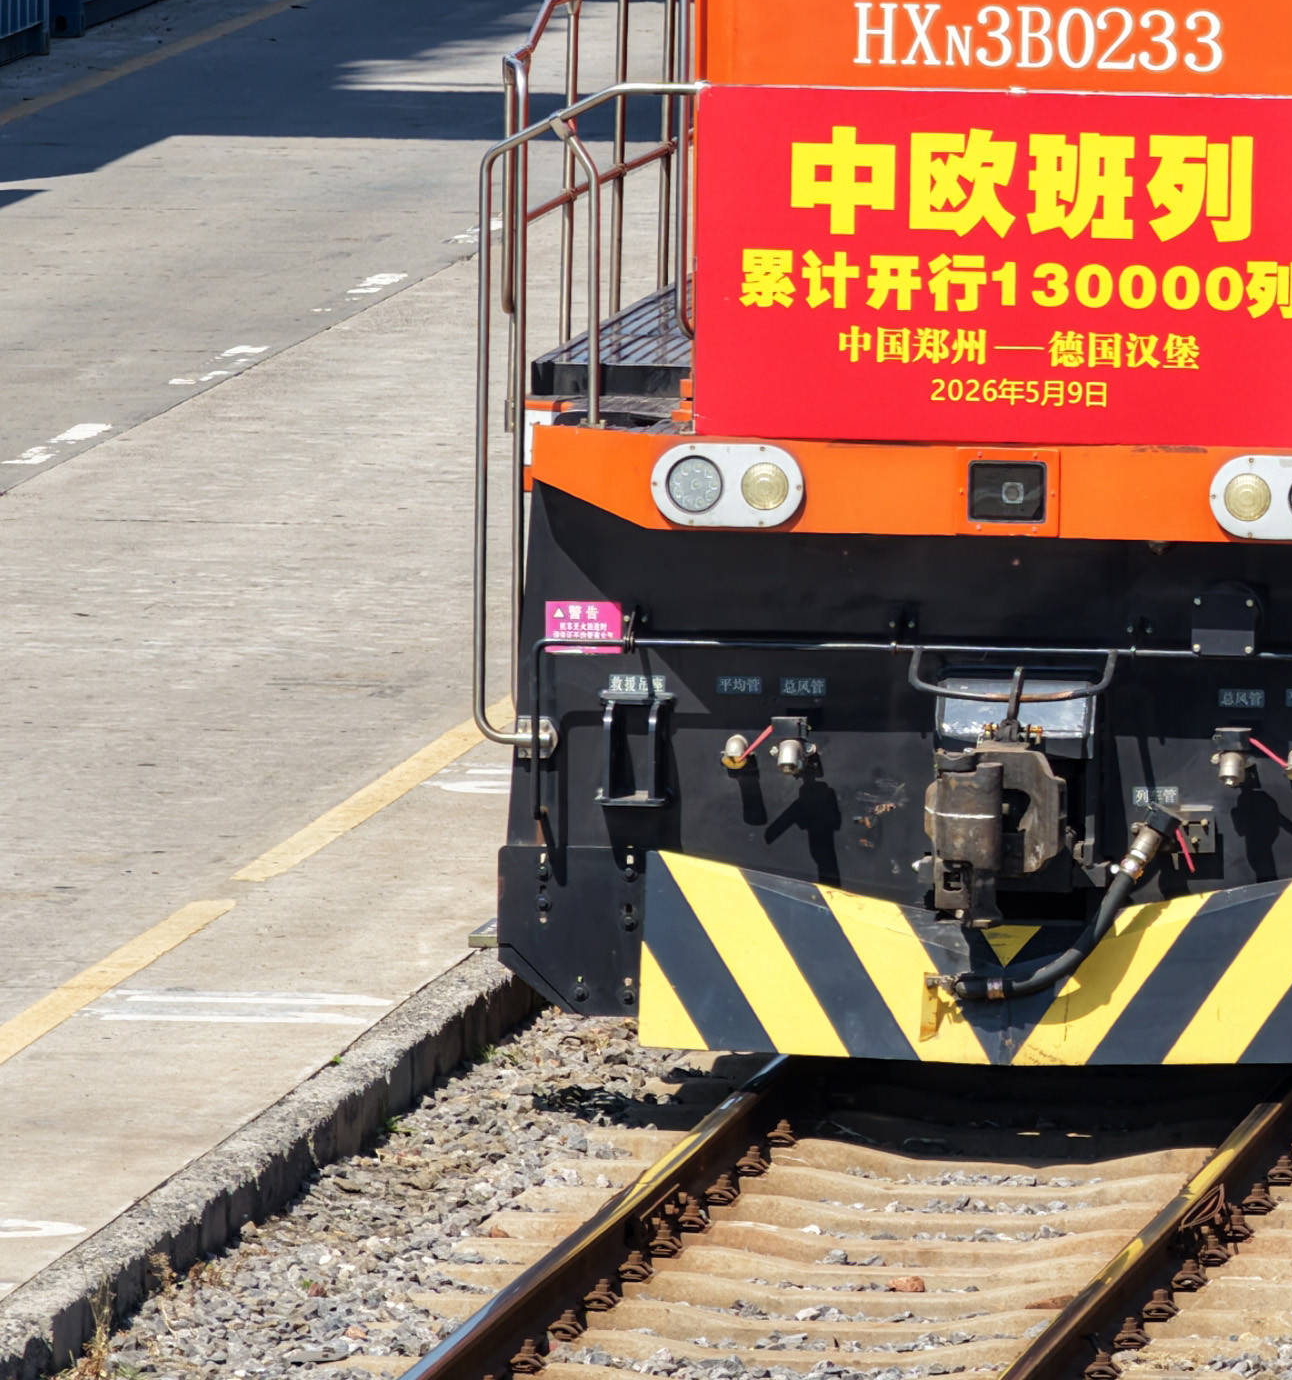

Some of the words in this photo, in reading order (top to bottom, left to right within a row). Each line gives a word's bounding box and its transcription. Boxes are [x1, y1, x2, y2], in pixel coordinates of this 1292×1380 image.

[853, 1, 1223, 73] HXN3B0233
[790, 125, 1254, 243] 中欧班列
[930, 378, 1107, 408] 2026年5月9日
[719, 678, 761, 692] 平均管
[783, 679, 825, 694] 总风管
[1221, 690, 1264, 706] 总风管
